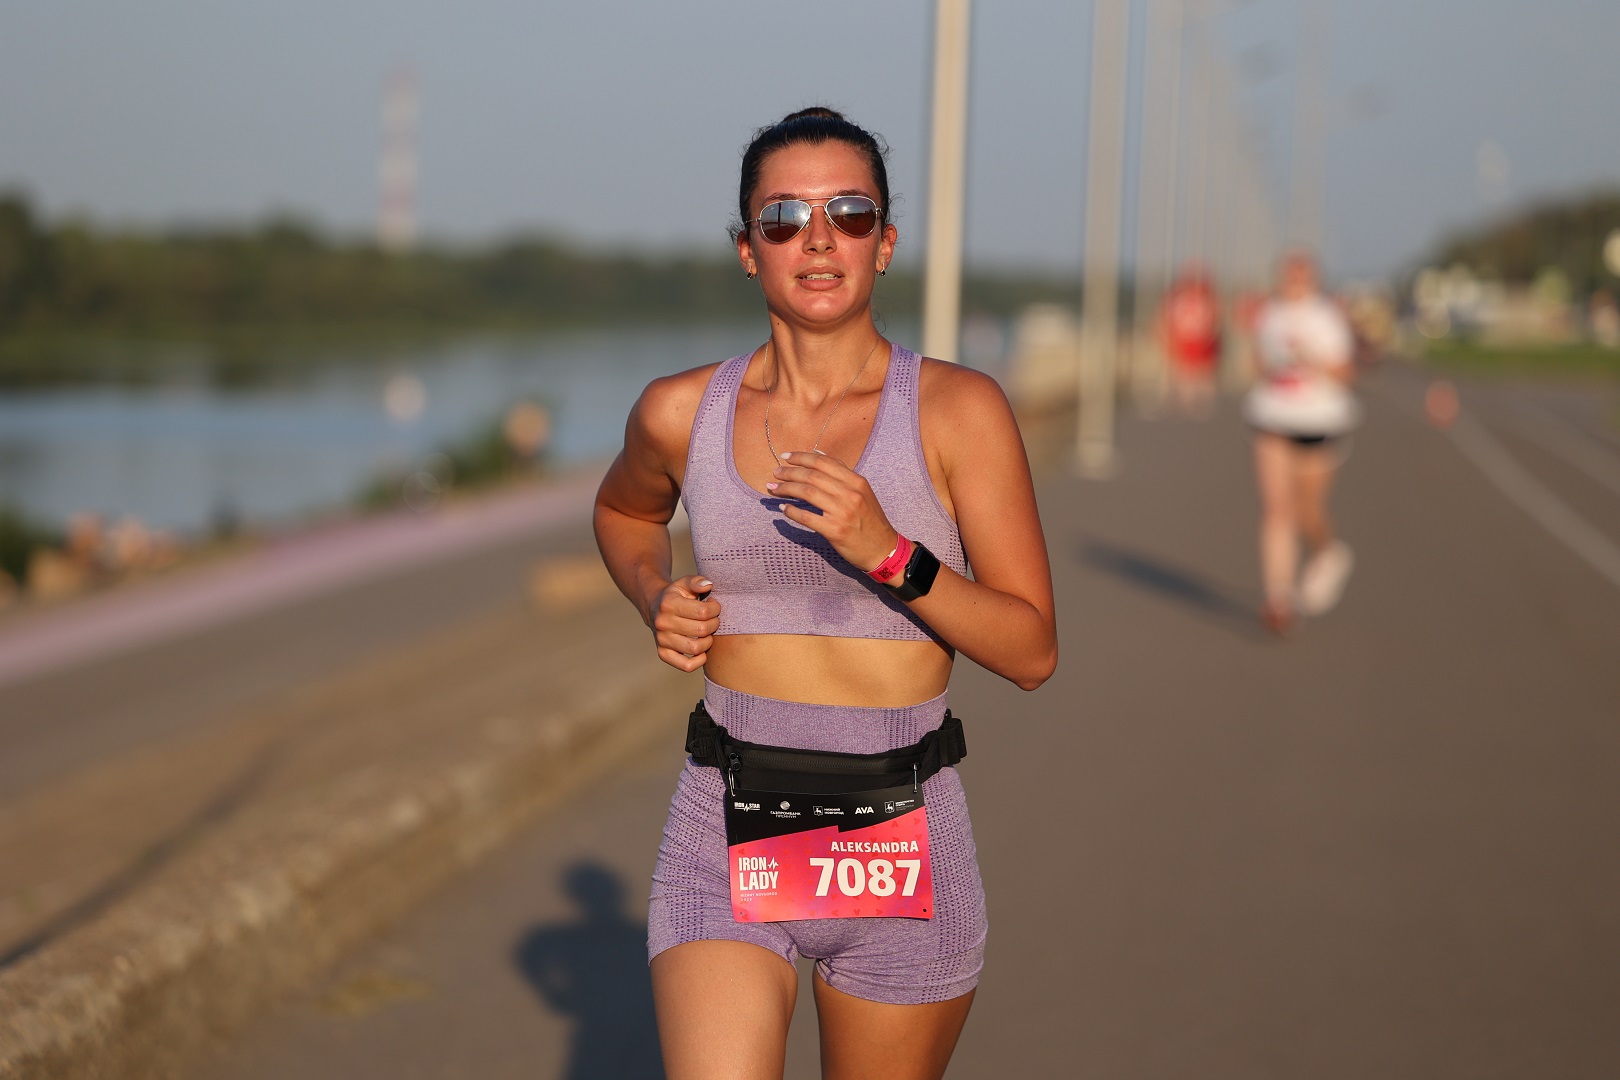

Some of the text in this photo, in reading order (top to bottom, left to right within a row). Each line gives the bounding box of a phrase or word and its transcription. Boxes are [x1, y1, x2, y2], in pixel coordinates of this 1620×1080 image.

[854, 806, 875, 815] AVA
[830, 840, 919, 853] ALEKSANDRA
[738, 857, 767, 871] IRON
[739, 871, 779, 891] LADY
[809, 857, 921, 897] 7087
